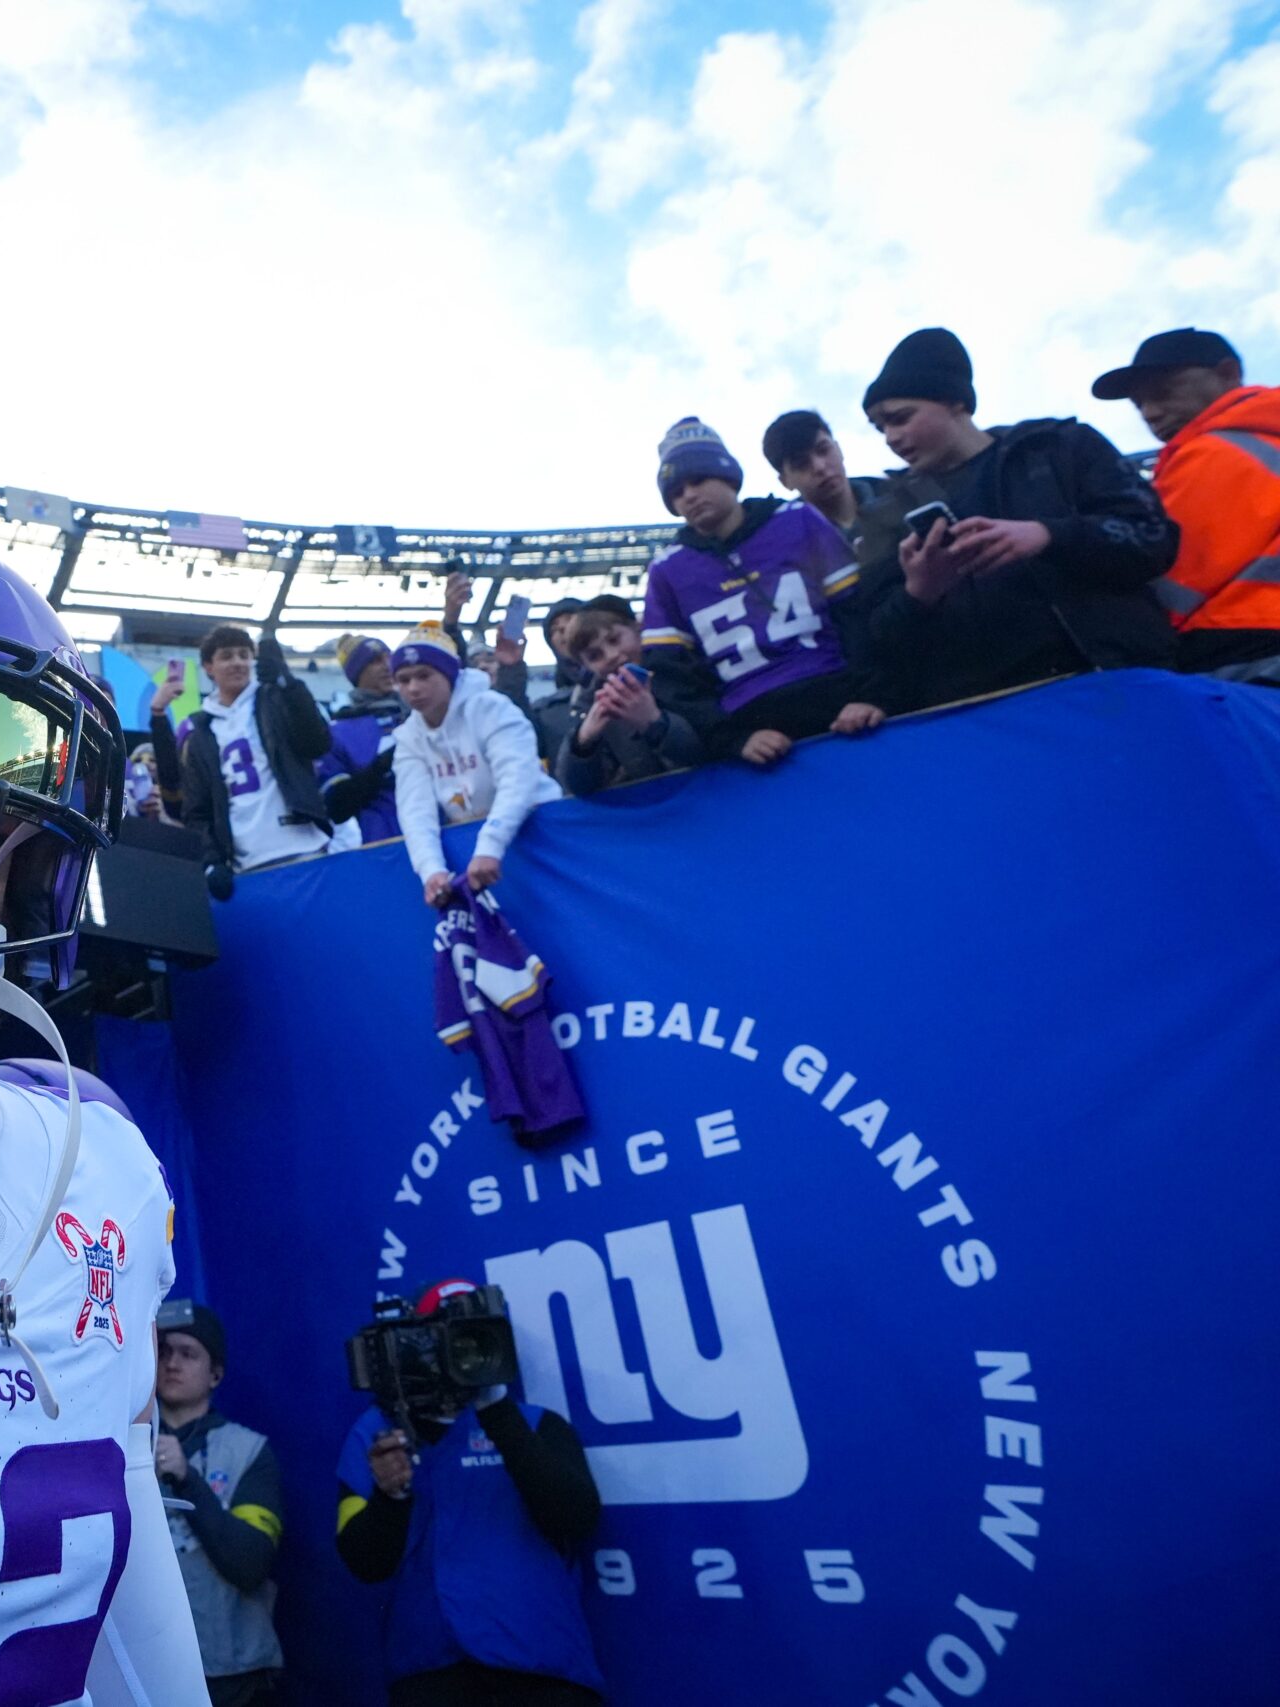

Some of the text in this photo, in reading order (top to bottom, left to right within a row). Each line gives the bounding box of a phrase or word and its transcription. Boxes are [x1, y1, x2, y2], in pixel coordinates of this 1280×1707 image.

[690, 571, 822, 681] 54
[394, 1000, 998, 1288] YORK OTBALL GIANTS
[468, 1109, 742, 1216] SINCE
[91, 1268, 112, 1301] NFL
[94, 1315, 110, 1330] 2025
[594, 1548, 866, 1604] 925
[867, 1350, 1045, 1707] NEW YO
